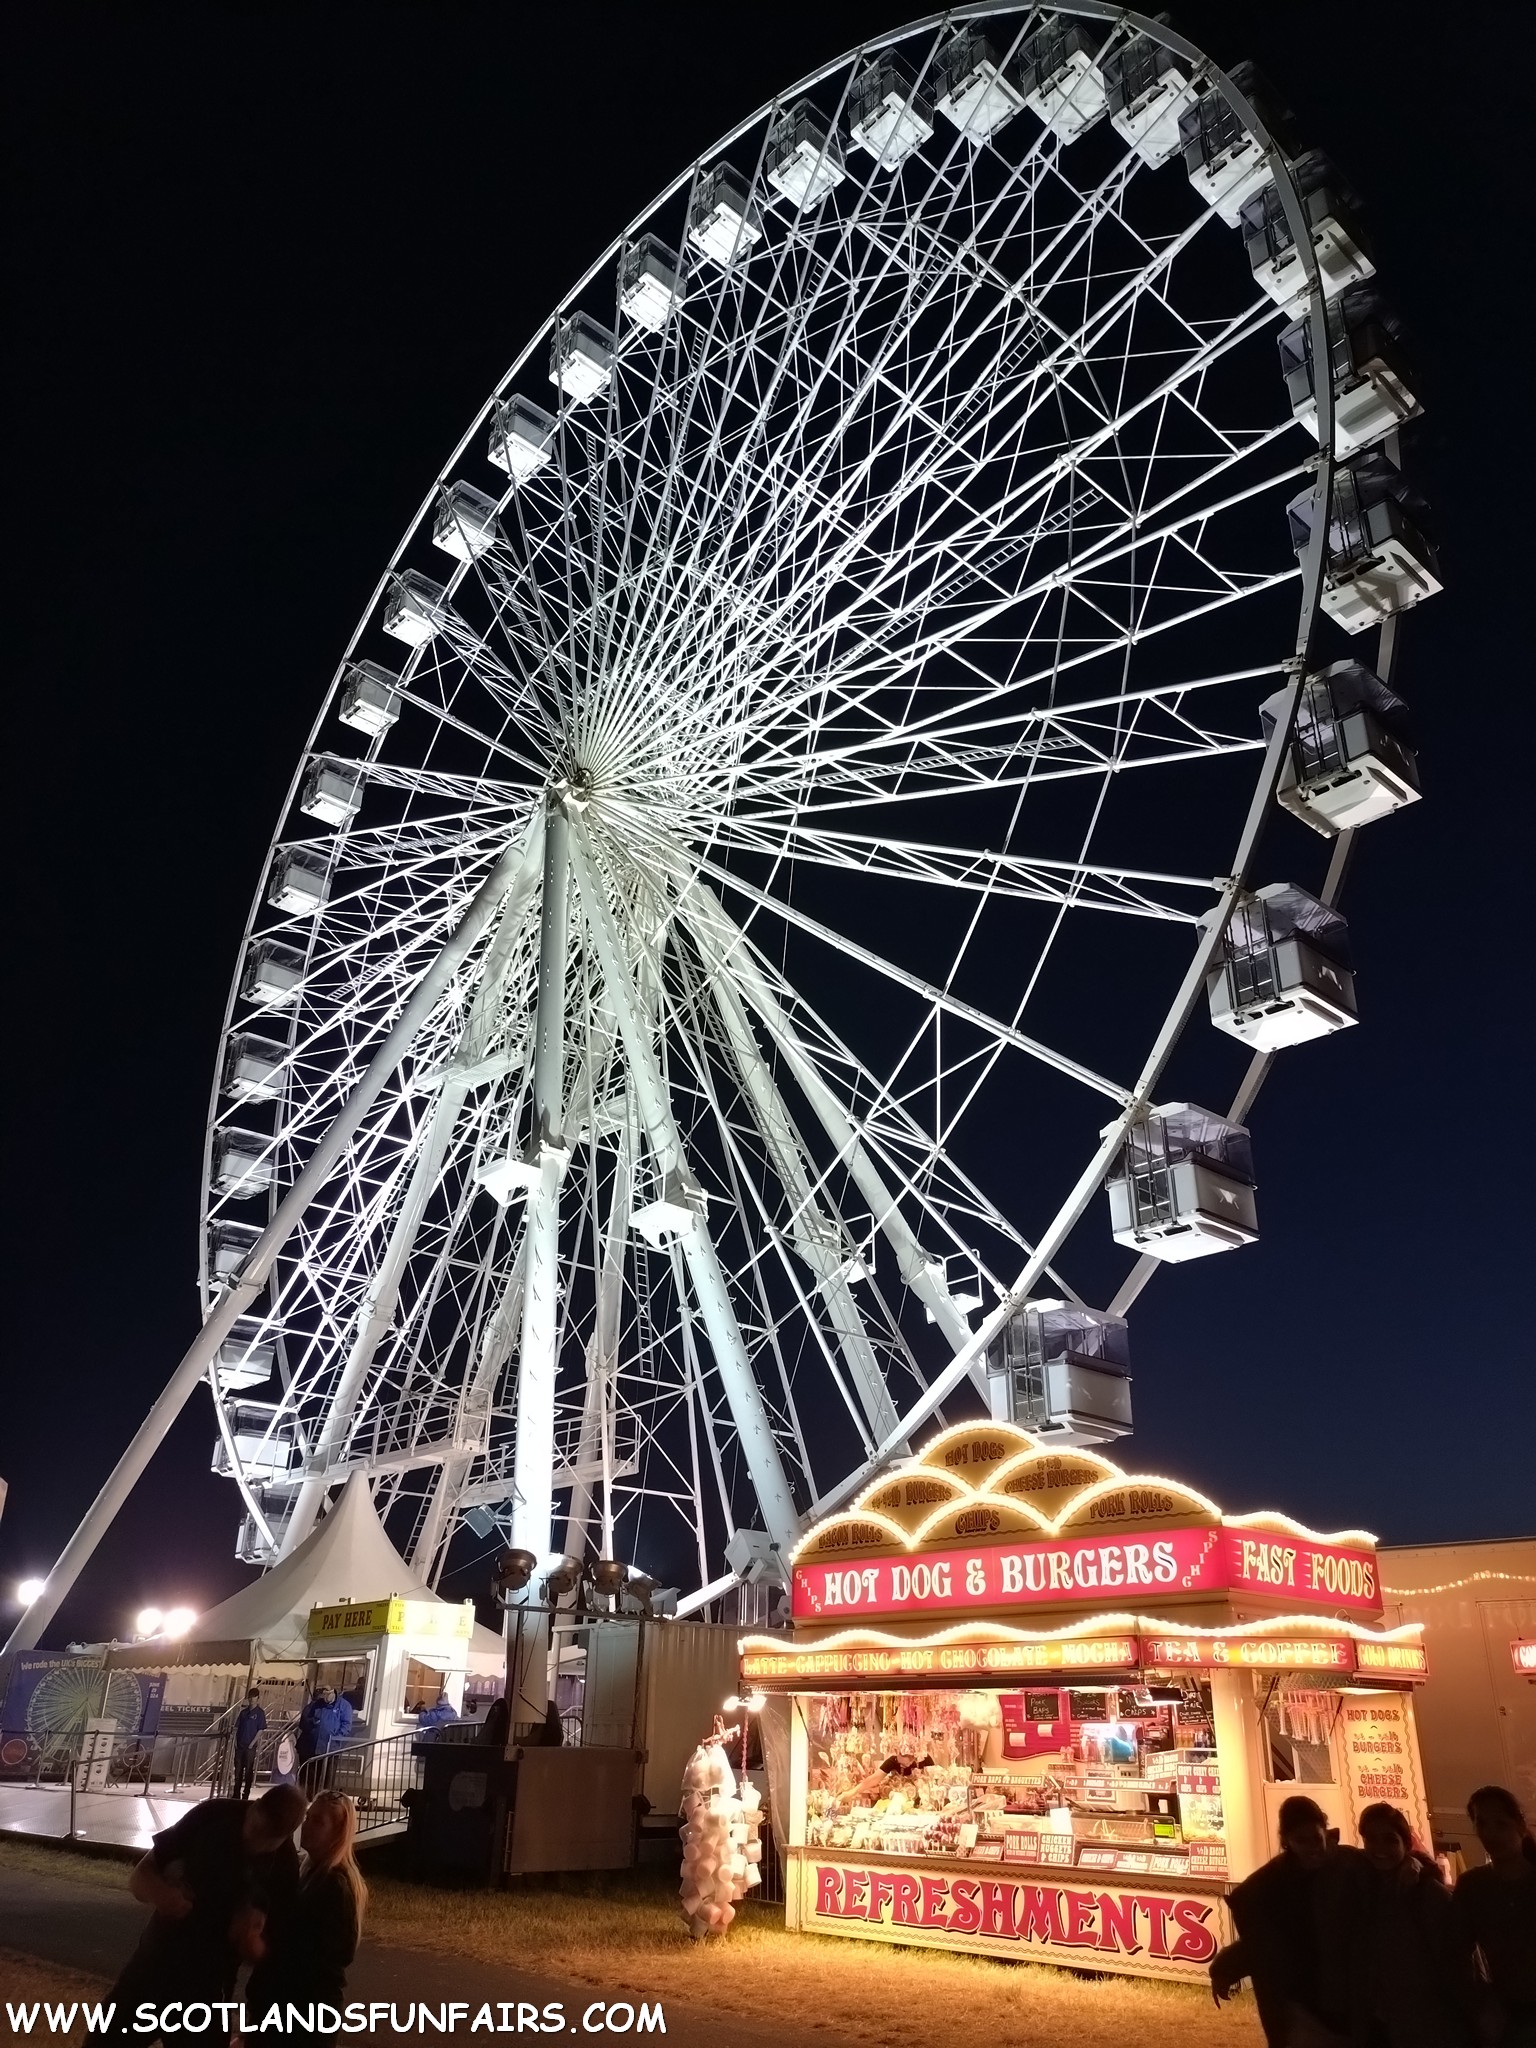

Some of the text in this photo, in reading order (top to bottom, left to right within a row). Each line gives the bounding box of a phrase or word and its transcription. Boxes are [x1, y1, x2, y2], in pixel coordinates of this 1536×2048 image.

[945, 1440, 1006, 1467] HOT DOGS
[906, 1481, 952, 1505] BURGERS
[1004, 1469, 1099, 1493] CHEESE BURGERS
[1090, 1490, 1174, 1518] PORK ROLLS
[955, 1509, 1001, 1535] CHIPS
[819, 1522, 884, 1549] BACON ROLLS
[824, 1541, 1178, 1606] HOT DOG & BURGERS
[1241, 1540, 1376, 1600] FAST FOODS
[321, 1610, 373, 1630] PAY HERE
[21, 1662, 32, 1671] We
[33, 1661, 48, 1669] rode
[49, 1659, 60, 1668] the
[743, 1656, 788, 1675] LATTE
[795, 1651, 891, 1674] CAPPUCCINO
[900, 1649, 935, 1670] HOT
[940, 1644, 1048, 1670] CHOCOLATE
[1061, 1641, 1133, 1665] MOCHA
[1147, 1641, 1349, 1666] TEA & COFFEE
[1358, 1643, 1426, 1670] COLD DRINKS
[1346, 1710, 1401, 1722] HOT DOGS
[1352, 1741, 1403, 1754] BURGERS
[1360, 1773, 1403, 1786] CHEESE
[1357, 1785, 1409, 1799] BURGERS
[1041, 1834, 1073, 1845] CHICKEN
[1041, 1844, 1072, 1855] NUGGETS
[1048, 1853, 1070, 1864] CHIPS
[814, 1864, 1217, 1964] REFRESHMENTS
